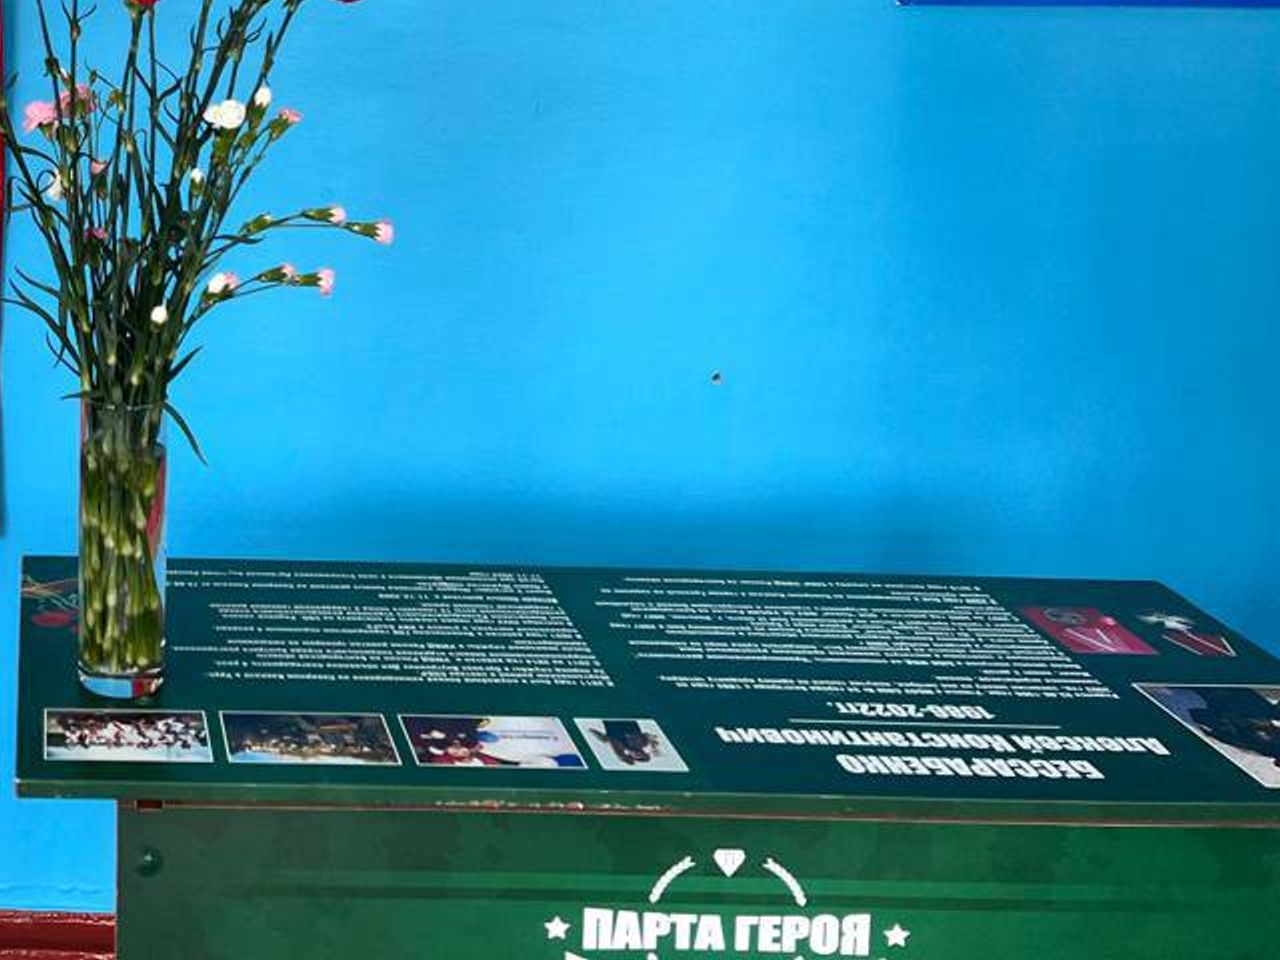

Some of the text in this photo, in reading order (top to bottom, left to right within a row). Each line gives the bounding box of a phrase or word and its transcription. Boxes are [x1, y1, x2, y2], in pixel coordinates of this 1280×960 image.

[714, 726, 1172, 756] Алексей Константинович
[836, 753, 1106, 780] БЕССАРАБЕНКО
[582, 907, 872, 957] ПАРТА ГЕРОЯ
